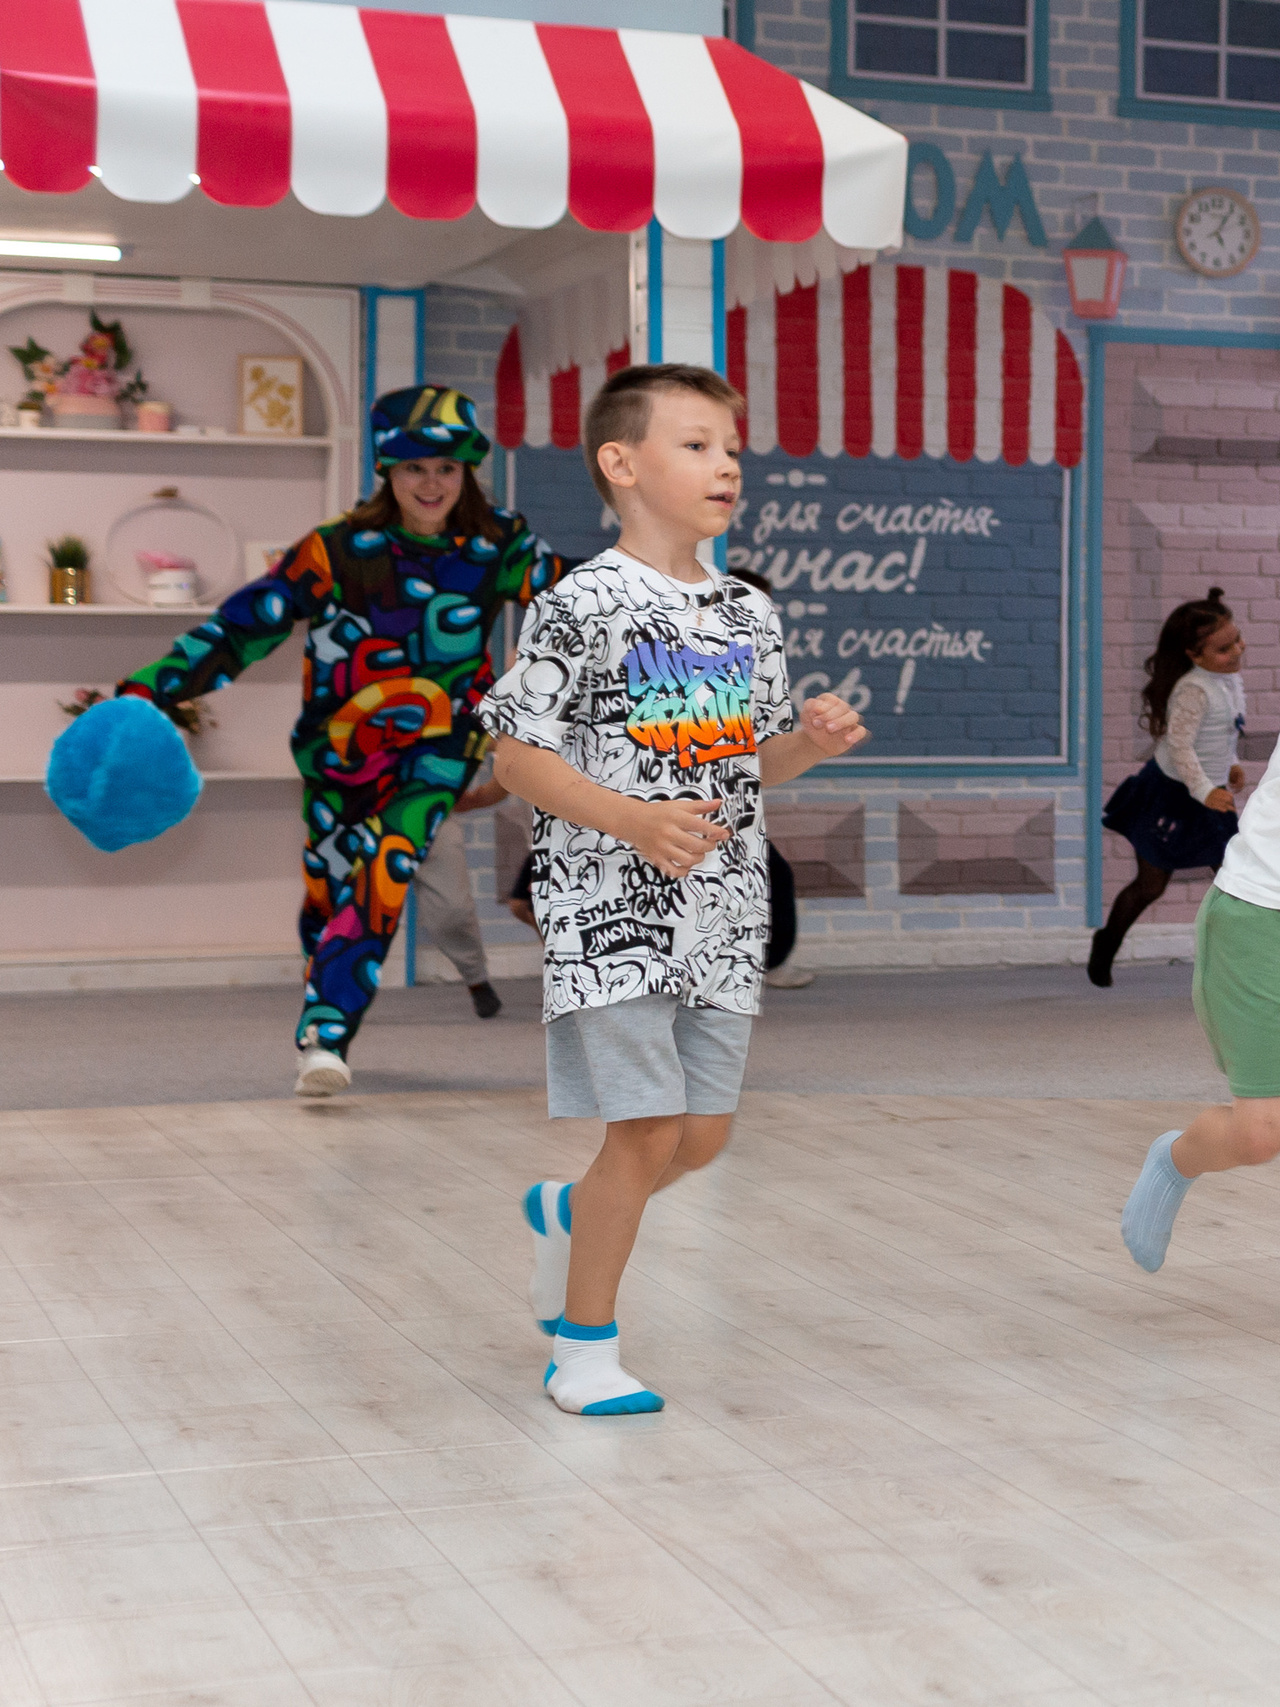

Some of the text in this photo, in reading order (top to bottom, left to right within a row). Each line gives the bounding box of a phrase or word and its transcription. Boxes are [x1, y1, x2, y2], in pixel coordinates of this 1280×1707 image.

[753, 499, 822, 545] для
[727, 537, 927, 594] ейчас!
[552, 915, 571, 935] OF
[574, 896, 628, 927] STYLE
